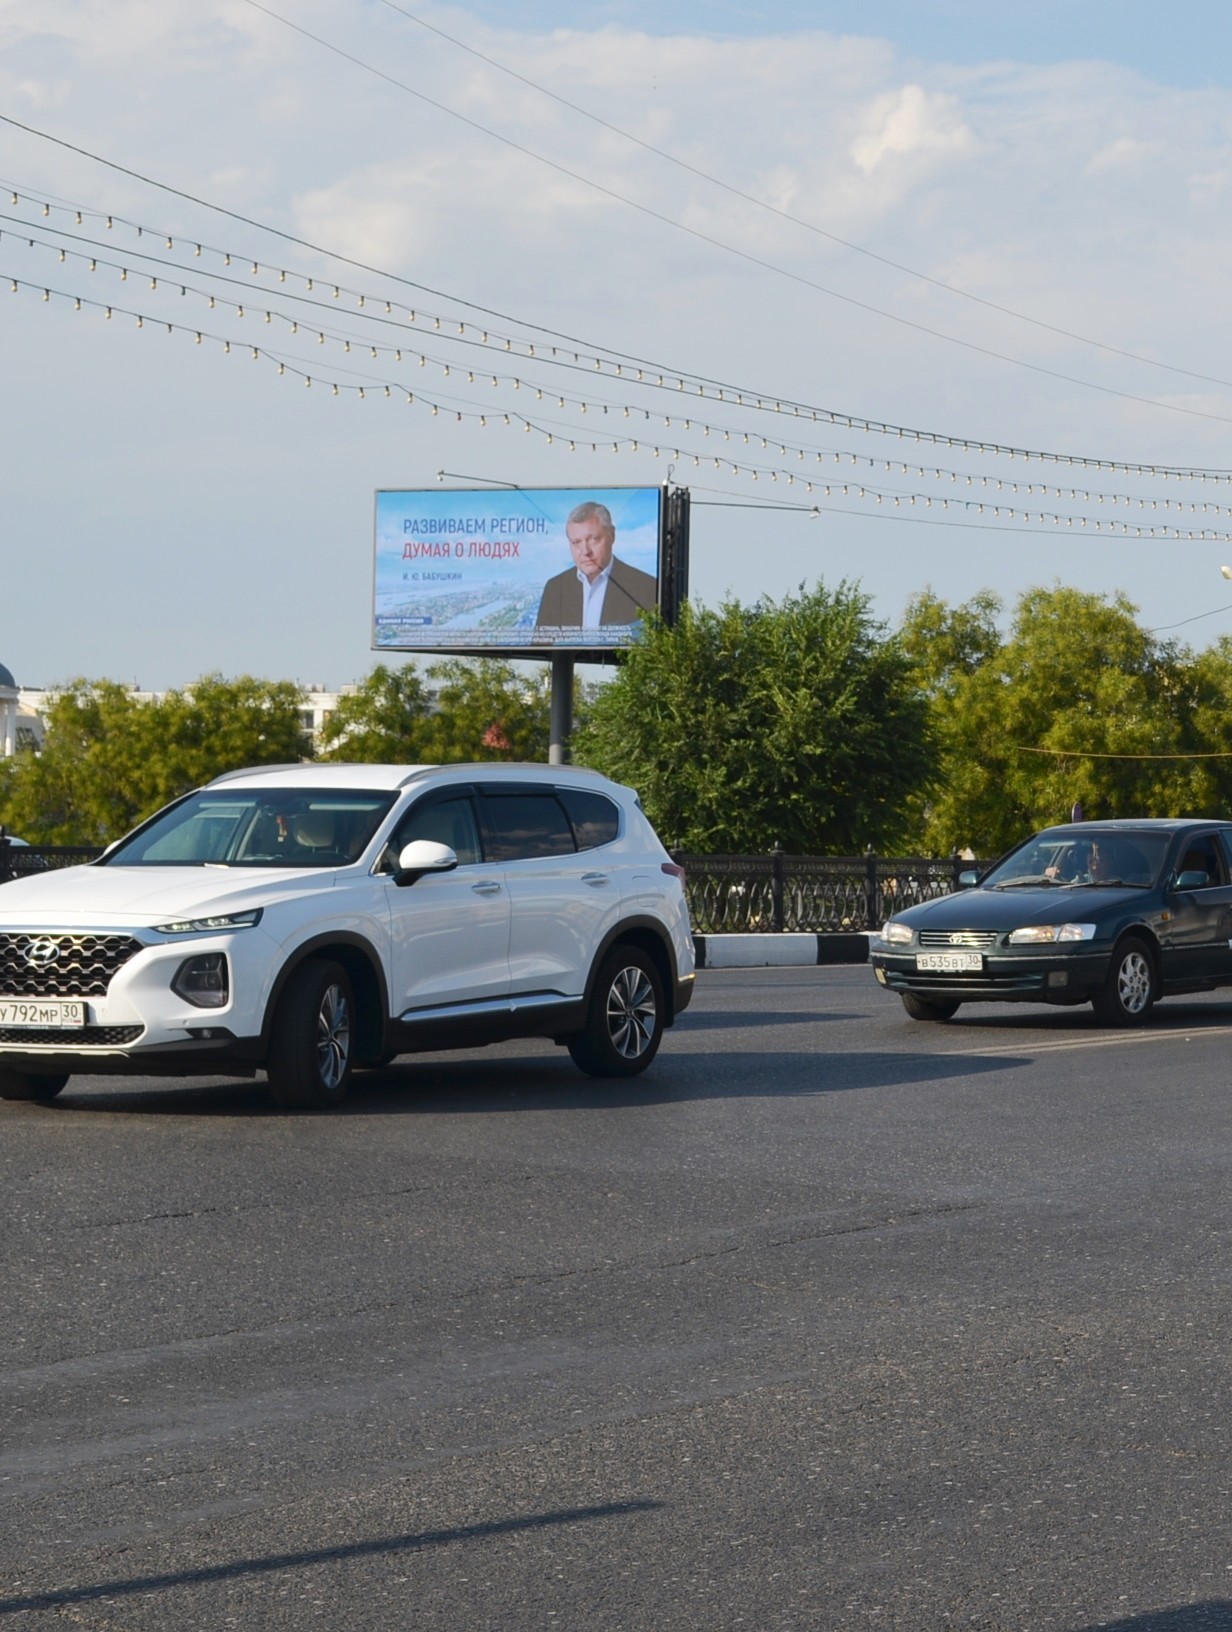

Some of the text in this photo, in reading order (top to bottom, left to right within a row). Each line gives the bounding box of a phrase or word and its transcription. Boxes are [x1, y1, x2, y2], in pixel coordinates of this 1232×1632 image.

[403, 517, 549, 535] РАЗВИВАЕМ РЕГИОН,
[402, 541, 520, 559] ДУМАЯ О ЛЮДЯХ
[422, 572, 462, 581] БАБУШКИН
[967, 954, 979, 965] 30
[63, 1004, 78, 1018] 30
